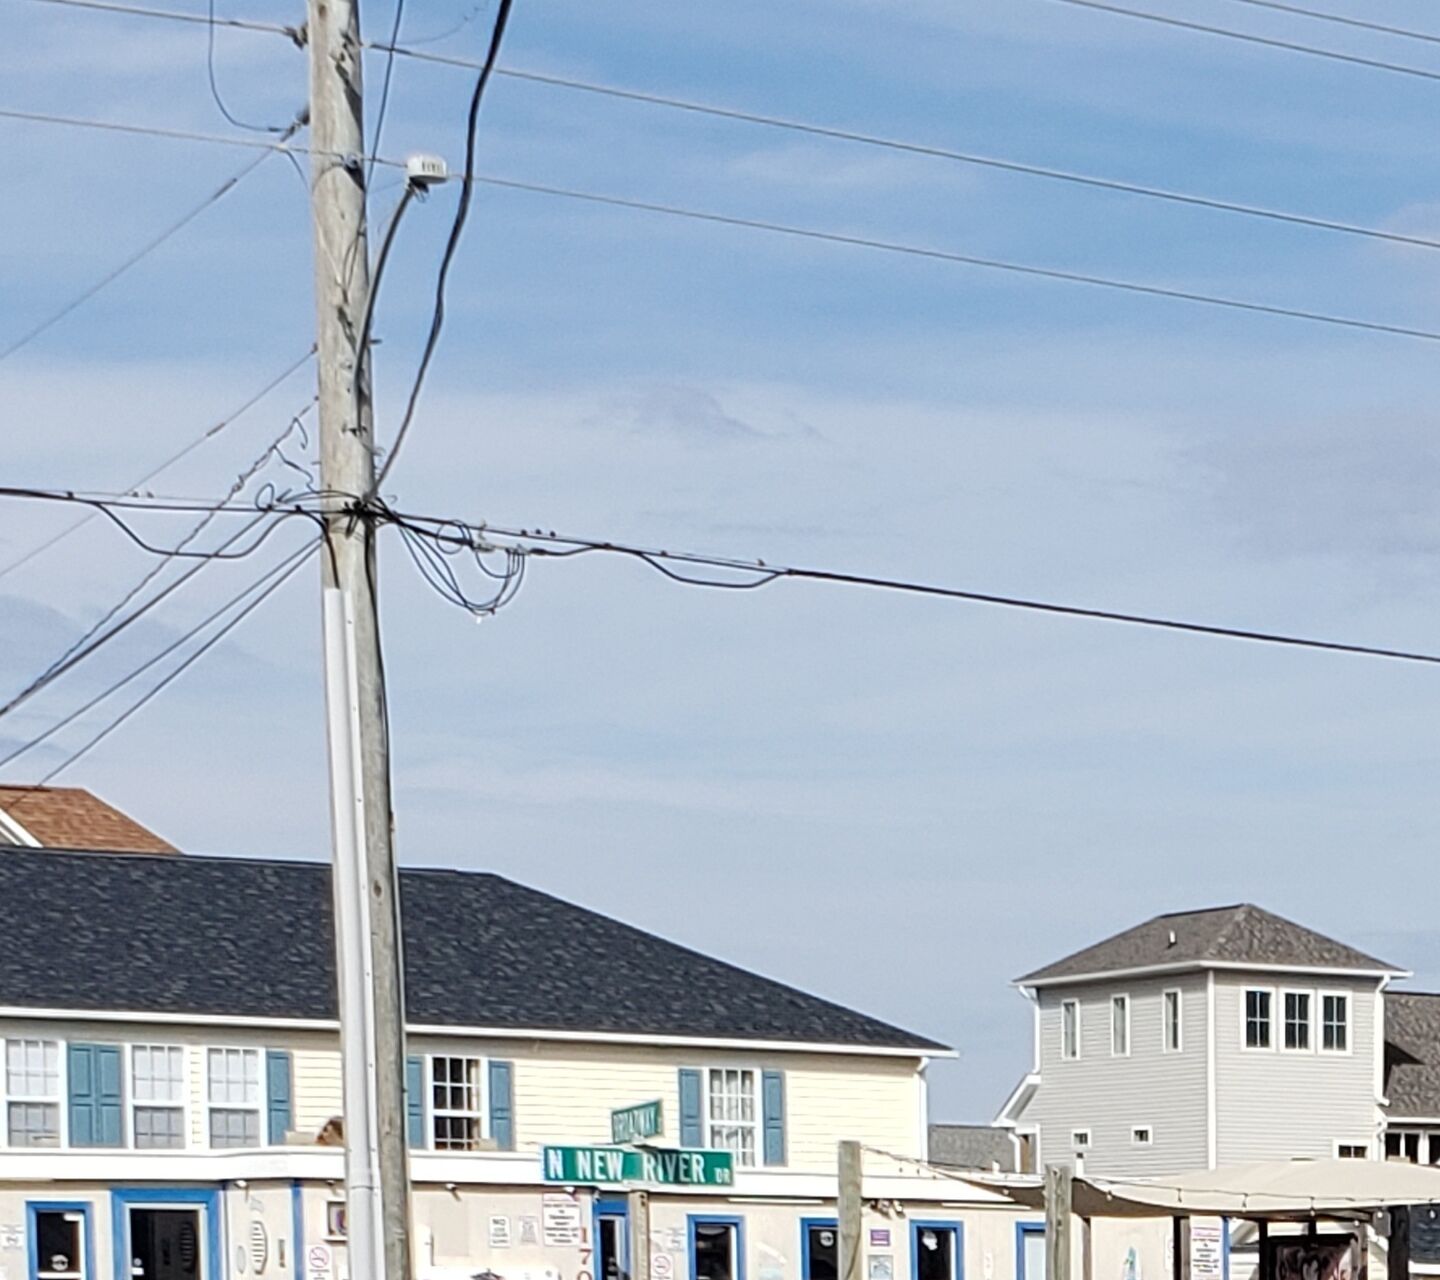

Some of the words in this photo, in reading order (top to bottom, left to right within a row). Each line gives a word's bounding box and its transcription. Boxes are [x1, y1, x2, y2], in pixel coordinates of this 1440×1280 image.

[547, 1149, 563, 1179] N
[576, 1149, 624, 1181] NEW
[644, 1152, 705, 1183] RIVER
[715, 1168, 730, 1183] DR
